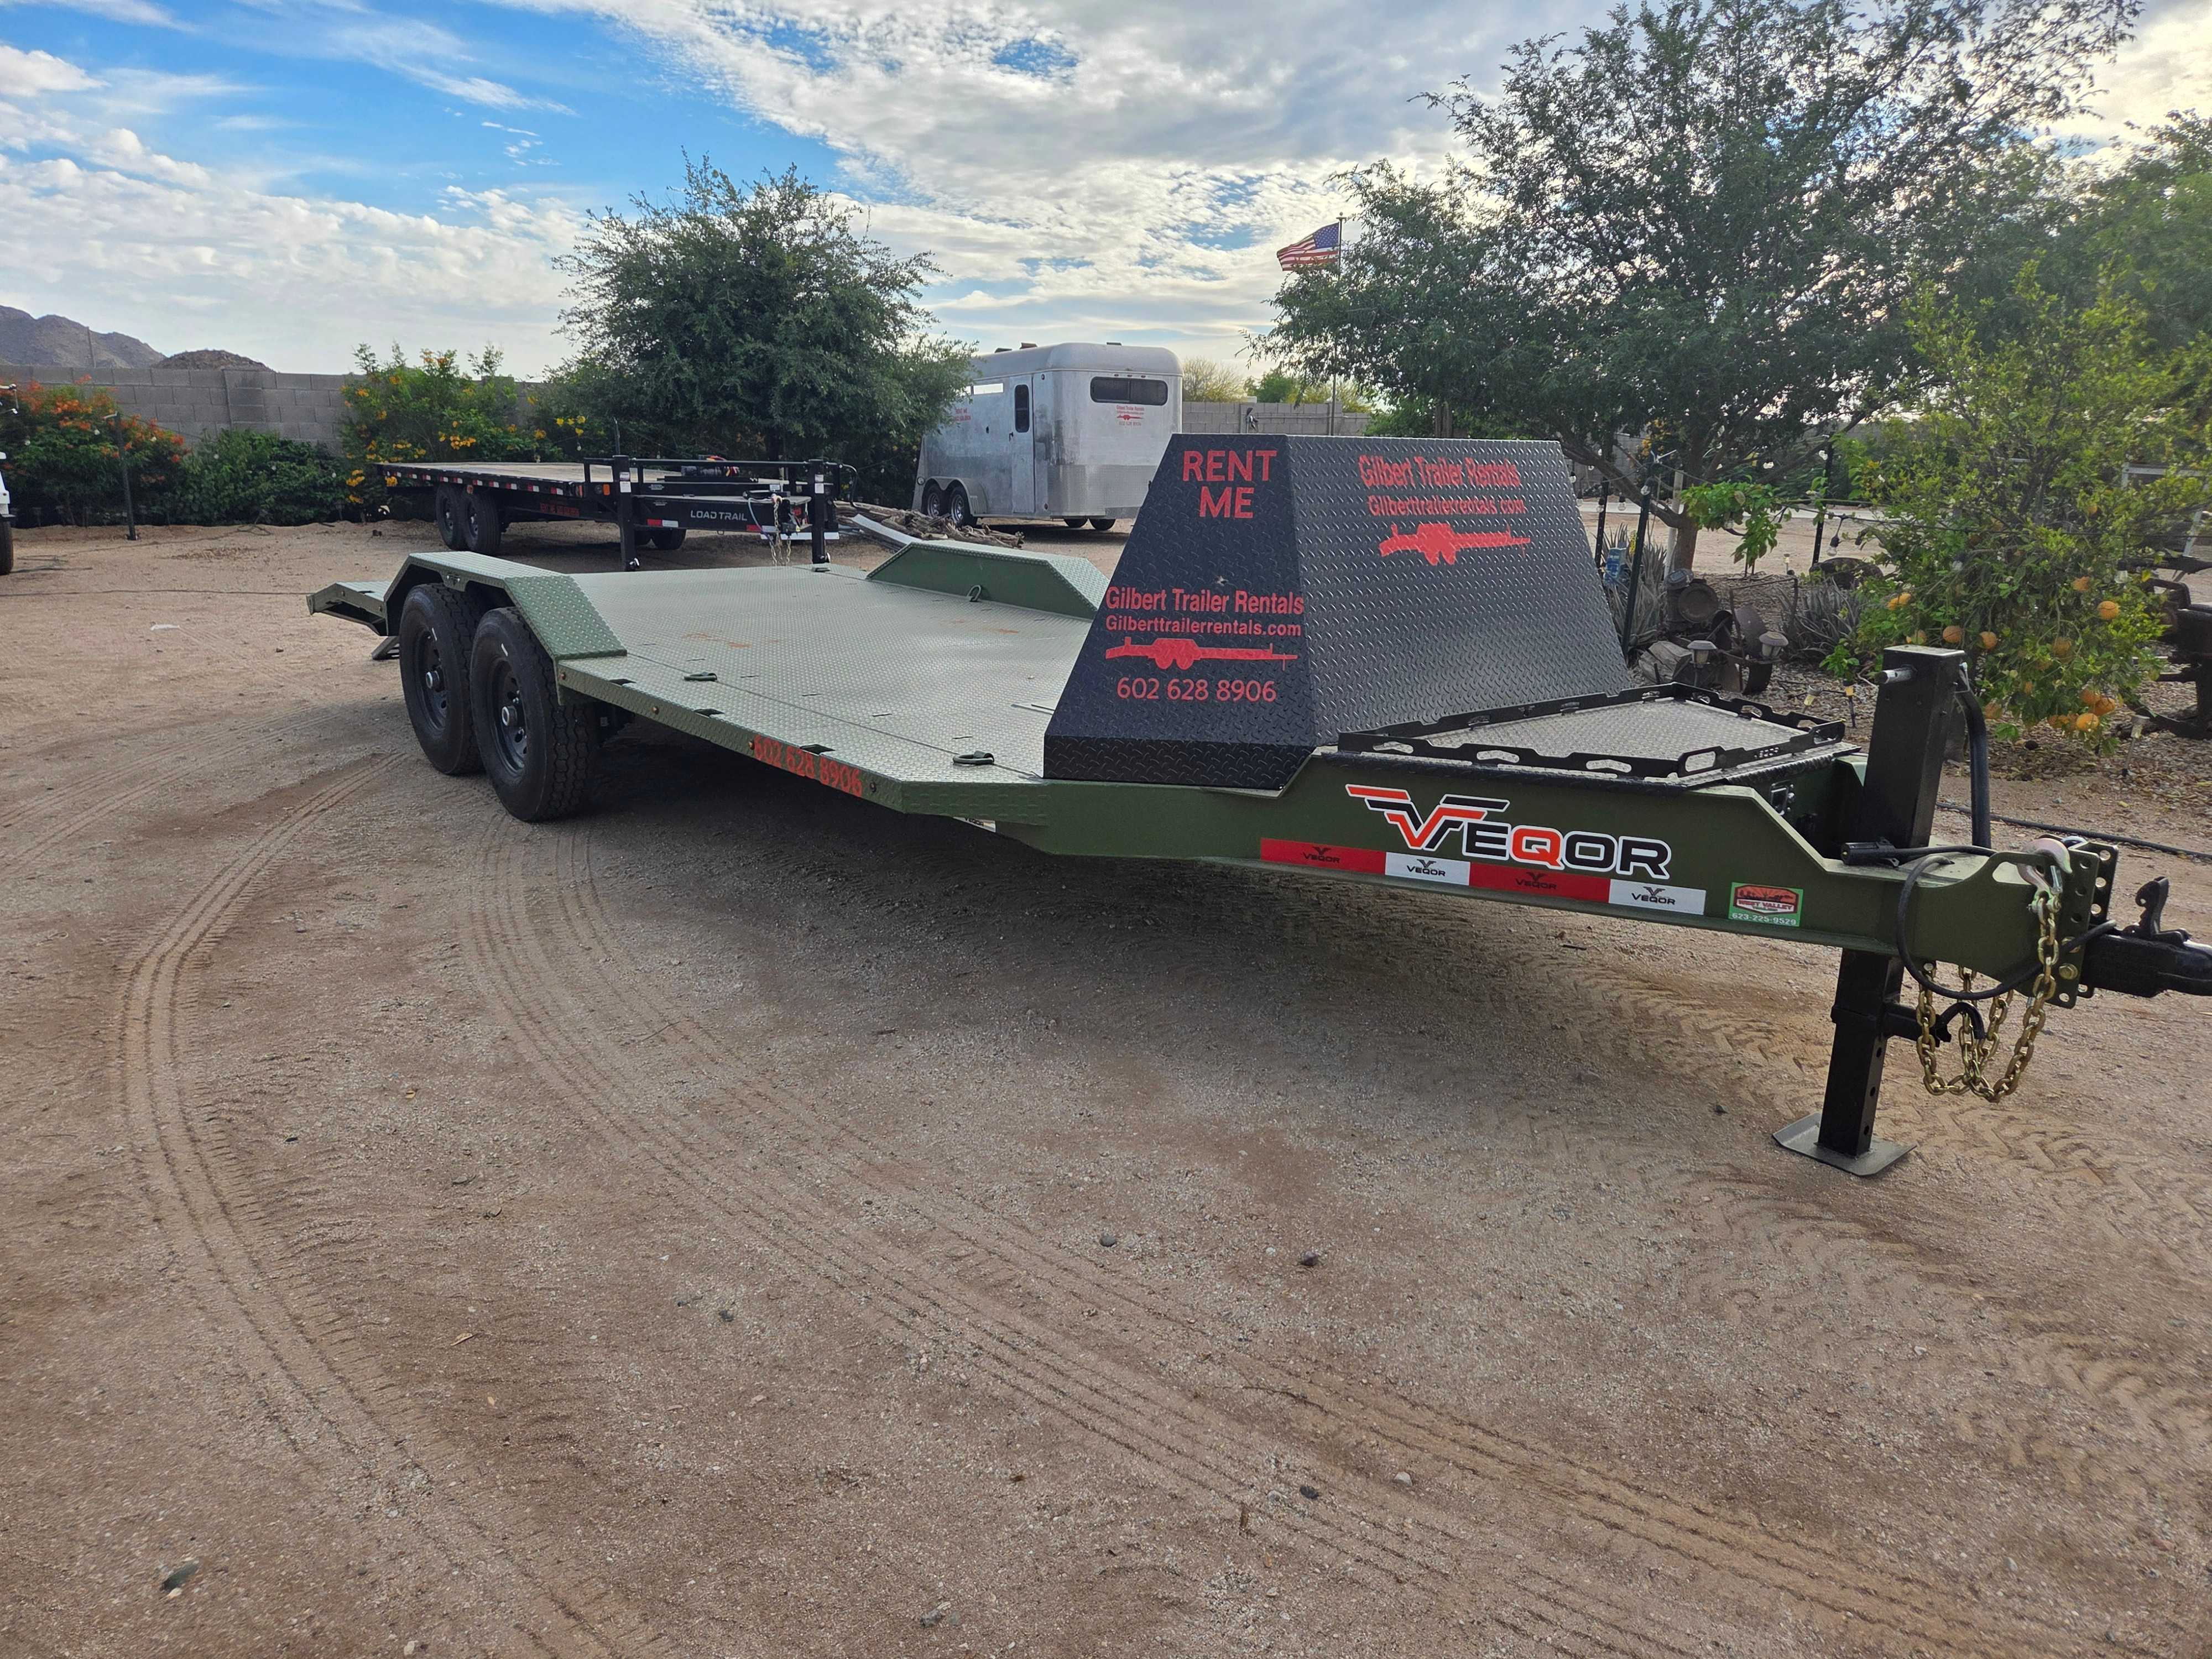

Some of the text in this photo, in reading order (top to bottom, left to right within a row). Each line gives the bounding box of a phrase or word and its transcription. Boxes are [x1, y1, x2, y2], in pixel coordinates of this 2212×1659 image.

[1183, 451, 1277, 481] RENT
[1358, 455, 1521, 487] Gilbert Trailer Rentals
[1199, 486, 1254, 518] ME
[1368, 495, 1526, 515] Gilberttrailerrentalscom
[690, 510, 748, 521] LOAD TRAIL
[1106, 586, 1305, 615] Gilbert Trailer Rentals
[1106, 615, 1301, 636] Gilberttrailerrentals.com
[1117, 678, 1276, 702] 602 628 8906
[754, 734, 863, 797] 602 628 8906
[1345, 784, 1671, 879] VEQOR
[1303, 852, 1340, 864] VEQOR
[1407, 865, 1446, 877] VEQOR
[1515, 878, 1557, 890] VEQOR
[1631, 893, 1676, 906] VEQOR
[1731, 912, 1797, 926] 623-225-9529
